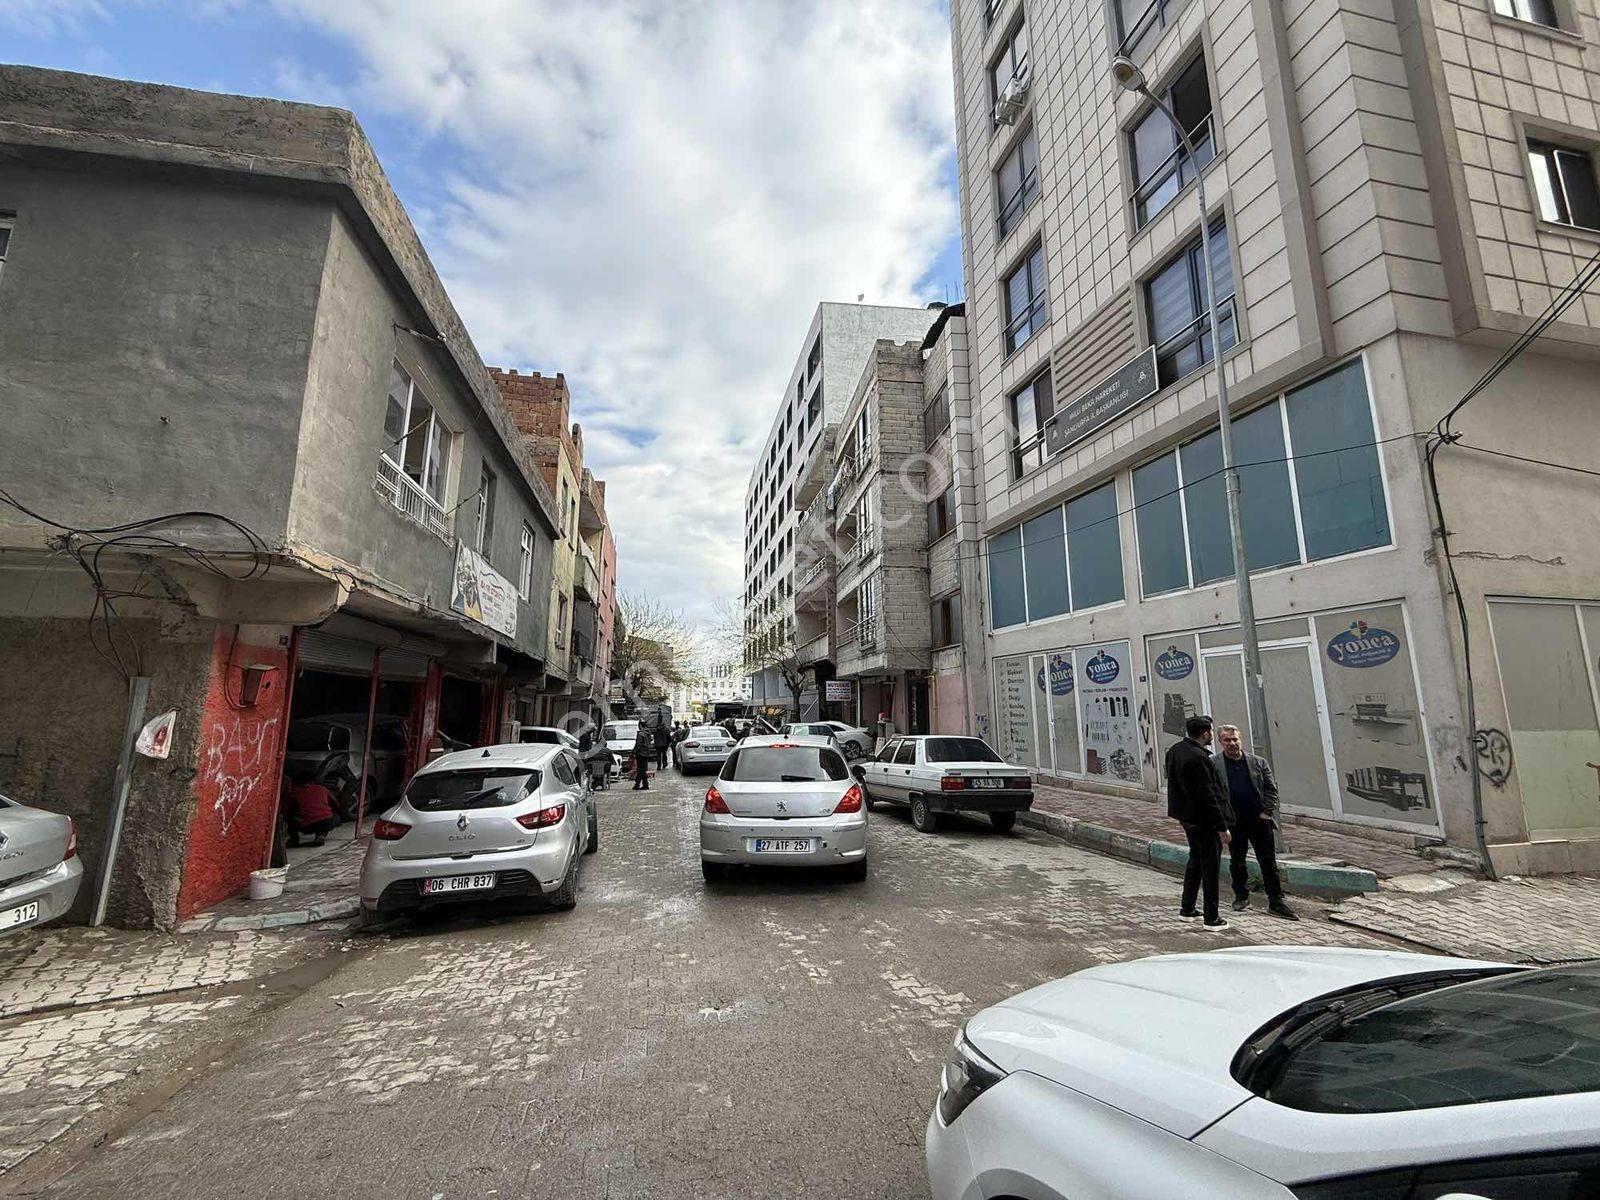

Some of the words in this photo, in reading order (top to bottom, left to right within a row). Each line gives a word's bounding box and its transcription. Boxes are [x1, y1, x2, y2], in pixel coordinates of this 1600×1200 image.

[1332, 635, 1394, 661] yonca
[1088, 661, 1117, 679] yonca
[1158, 656, 1191, 674] yonca
[761, 841, 771, 850] 27
[776, 841, 789, 850] ATF
[794, 841, 808, 850] 257
[432, 880, 444, 891] 06
[451, 877, 470, 889] CHR
[473, 875, 493, 888] 837
[14, 904, 36, 922] 312
